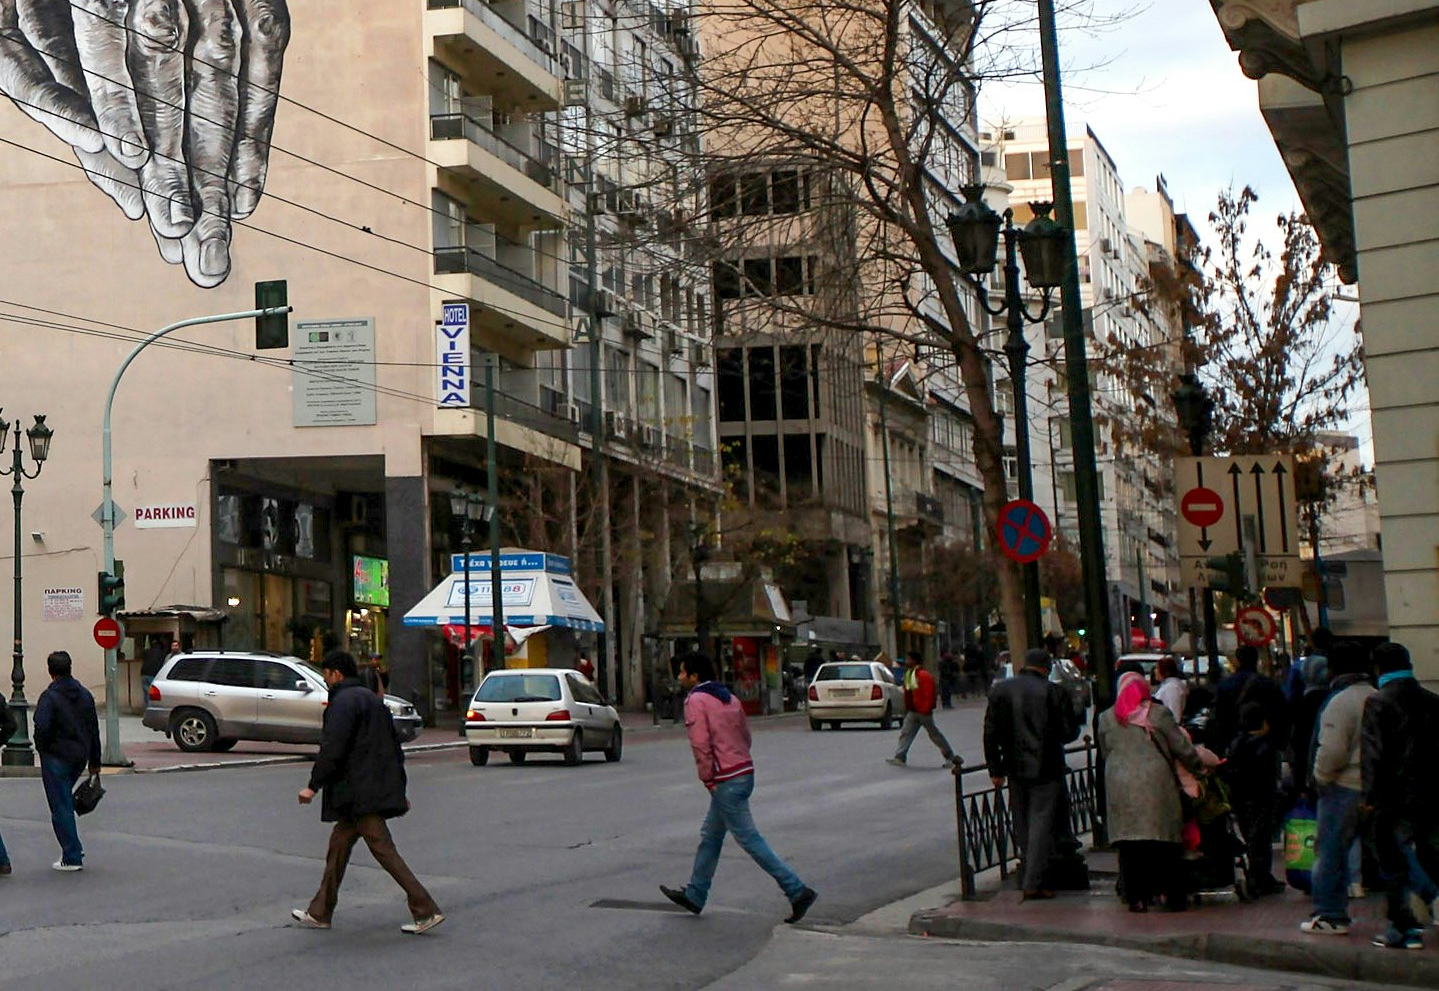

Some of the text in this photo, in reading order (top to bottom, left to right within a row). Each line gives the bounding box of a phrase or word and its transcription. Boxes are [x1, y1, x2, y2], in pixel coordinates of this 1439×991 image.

[444, 307, 467, 322] HOTEL
[440, 327, 467, 404] VIENNA
[135, 506, 195, 520] PARKING
[459, 558, 486, 567] Τέχα
